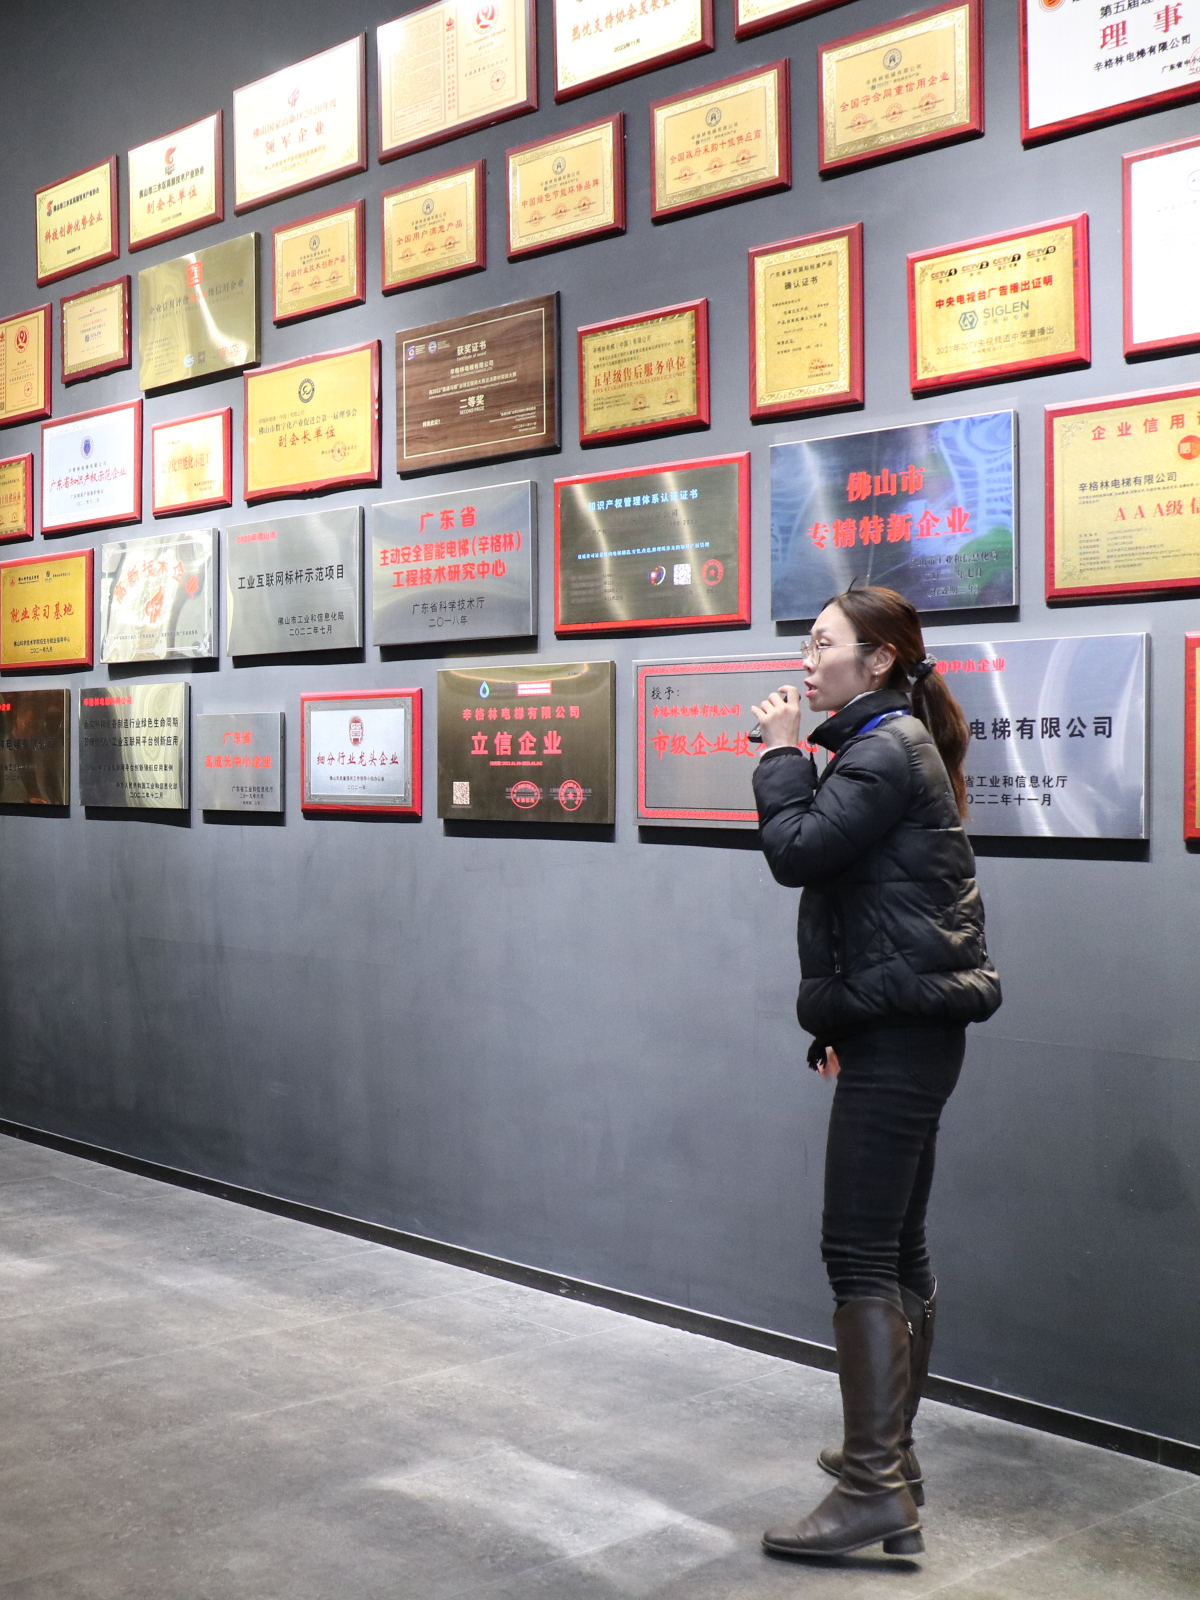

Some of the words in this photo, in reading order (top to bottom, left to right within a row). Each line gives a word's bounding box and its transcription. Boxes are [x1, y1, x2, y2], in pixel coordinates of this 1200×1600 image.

[571, 0, 680, 42] 热忱支持协会发展
[1099, 0, 1161, 19] 第五届
[1099, 2, 1184, 51] 理事
[1093, 33, 1191, 72] 辛格林电梯有限公司
[839, 71, 950, 113] 全国守合同重信用企业
[265, 121, 325, 155] 领军企业
[669, 129, 762, 165] 全国政府采购十佳供应商
[146, 185, 198, 214] 副会长单位
[521, 178, 600, 209] 中国绿色节能环保品牌
[44, 210, 103, 244] 科技创新优势企业
[396, 219, 463, 246] 全国用户满意产品
[285, 254, 346, 280] 中国行业技术创新产品
[784, 276, 818, 291] 确认证书
[935, 274, 1053, 310] 中央电视台广告播出证明
[983, 300, 1030, 319] SIGLEN
[456, 340, 487, 356] 获奖证书
[593, 355, 687, 388] 五星级售后服务单位
[459, 394, 485, 410] 二等奖
[258, 407, 358, 435] 佛山市数字化产业促进会第一届理事会
[278, 425, 336, 448] 副会长单位
[49, 468, 127, 493] 广东省知识产权示范企业
[846, 465, 926, 502] 佛山市
[1078, 471, 1177, 492] 辛格林电梯有限公司
[587, 488, 699, 512] 知识产权管理体系认证证书
[419, 506, 477, 534] 广东省
[806, 506, 972, 550] 专精特新企业
[379, 531, 523, 567] 主动安全智能电梯(辛格林)
[113, 559, 200, 604] 高新技术企业
[237, 564, 345, 591] 工业互联网标杆示范项目
[392, 558, 507, 588] 工程技术研究中心
[10, 601, 75, 624] 就业实习基地
[277, 611, 345, 625] 佛山市工业和信息化局
[412, 596, 485, 615] 广东省科学技术厅
[462, 705, 580, 721] 辛格林电梯有限公司
[651, 704, 741, 719] 辛格林电梯有限公司
[223, 731, 253, 745] 广东省
[970, 716, 1113, 740] 电梯有限公司
[470, 730, 563, 756] 立信企业
[204, 755, 273, 769] 高成长中小企业
[316, 750, 399, 767] 细分行业龙头企业
[964, 774, 1068, 789] 省工业和信息化厅
